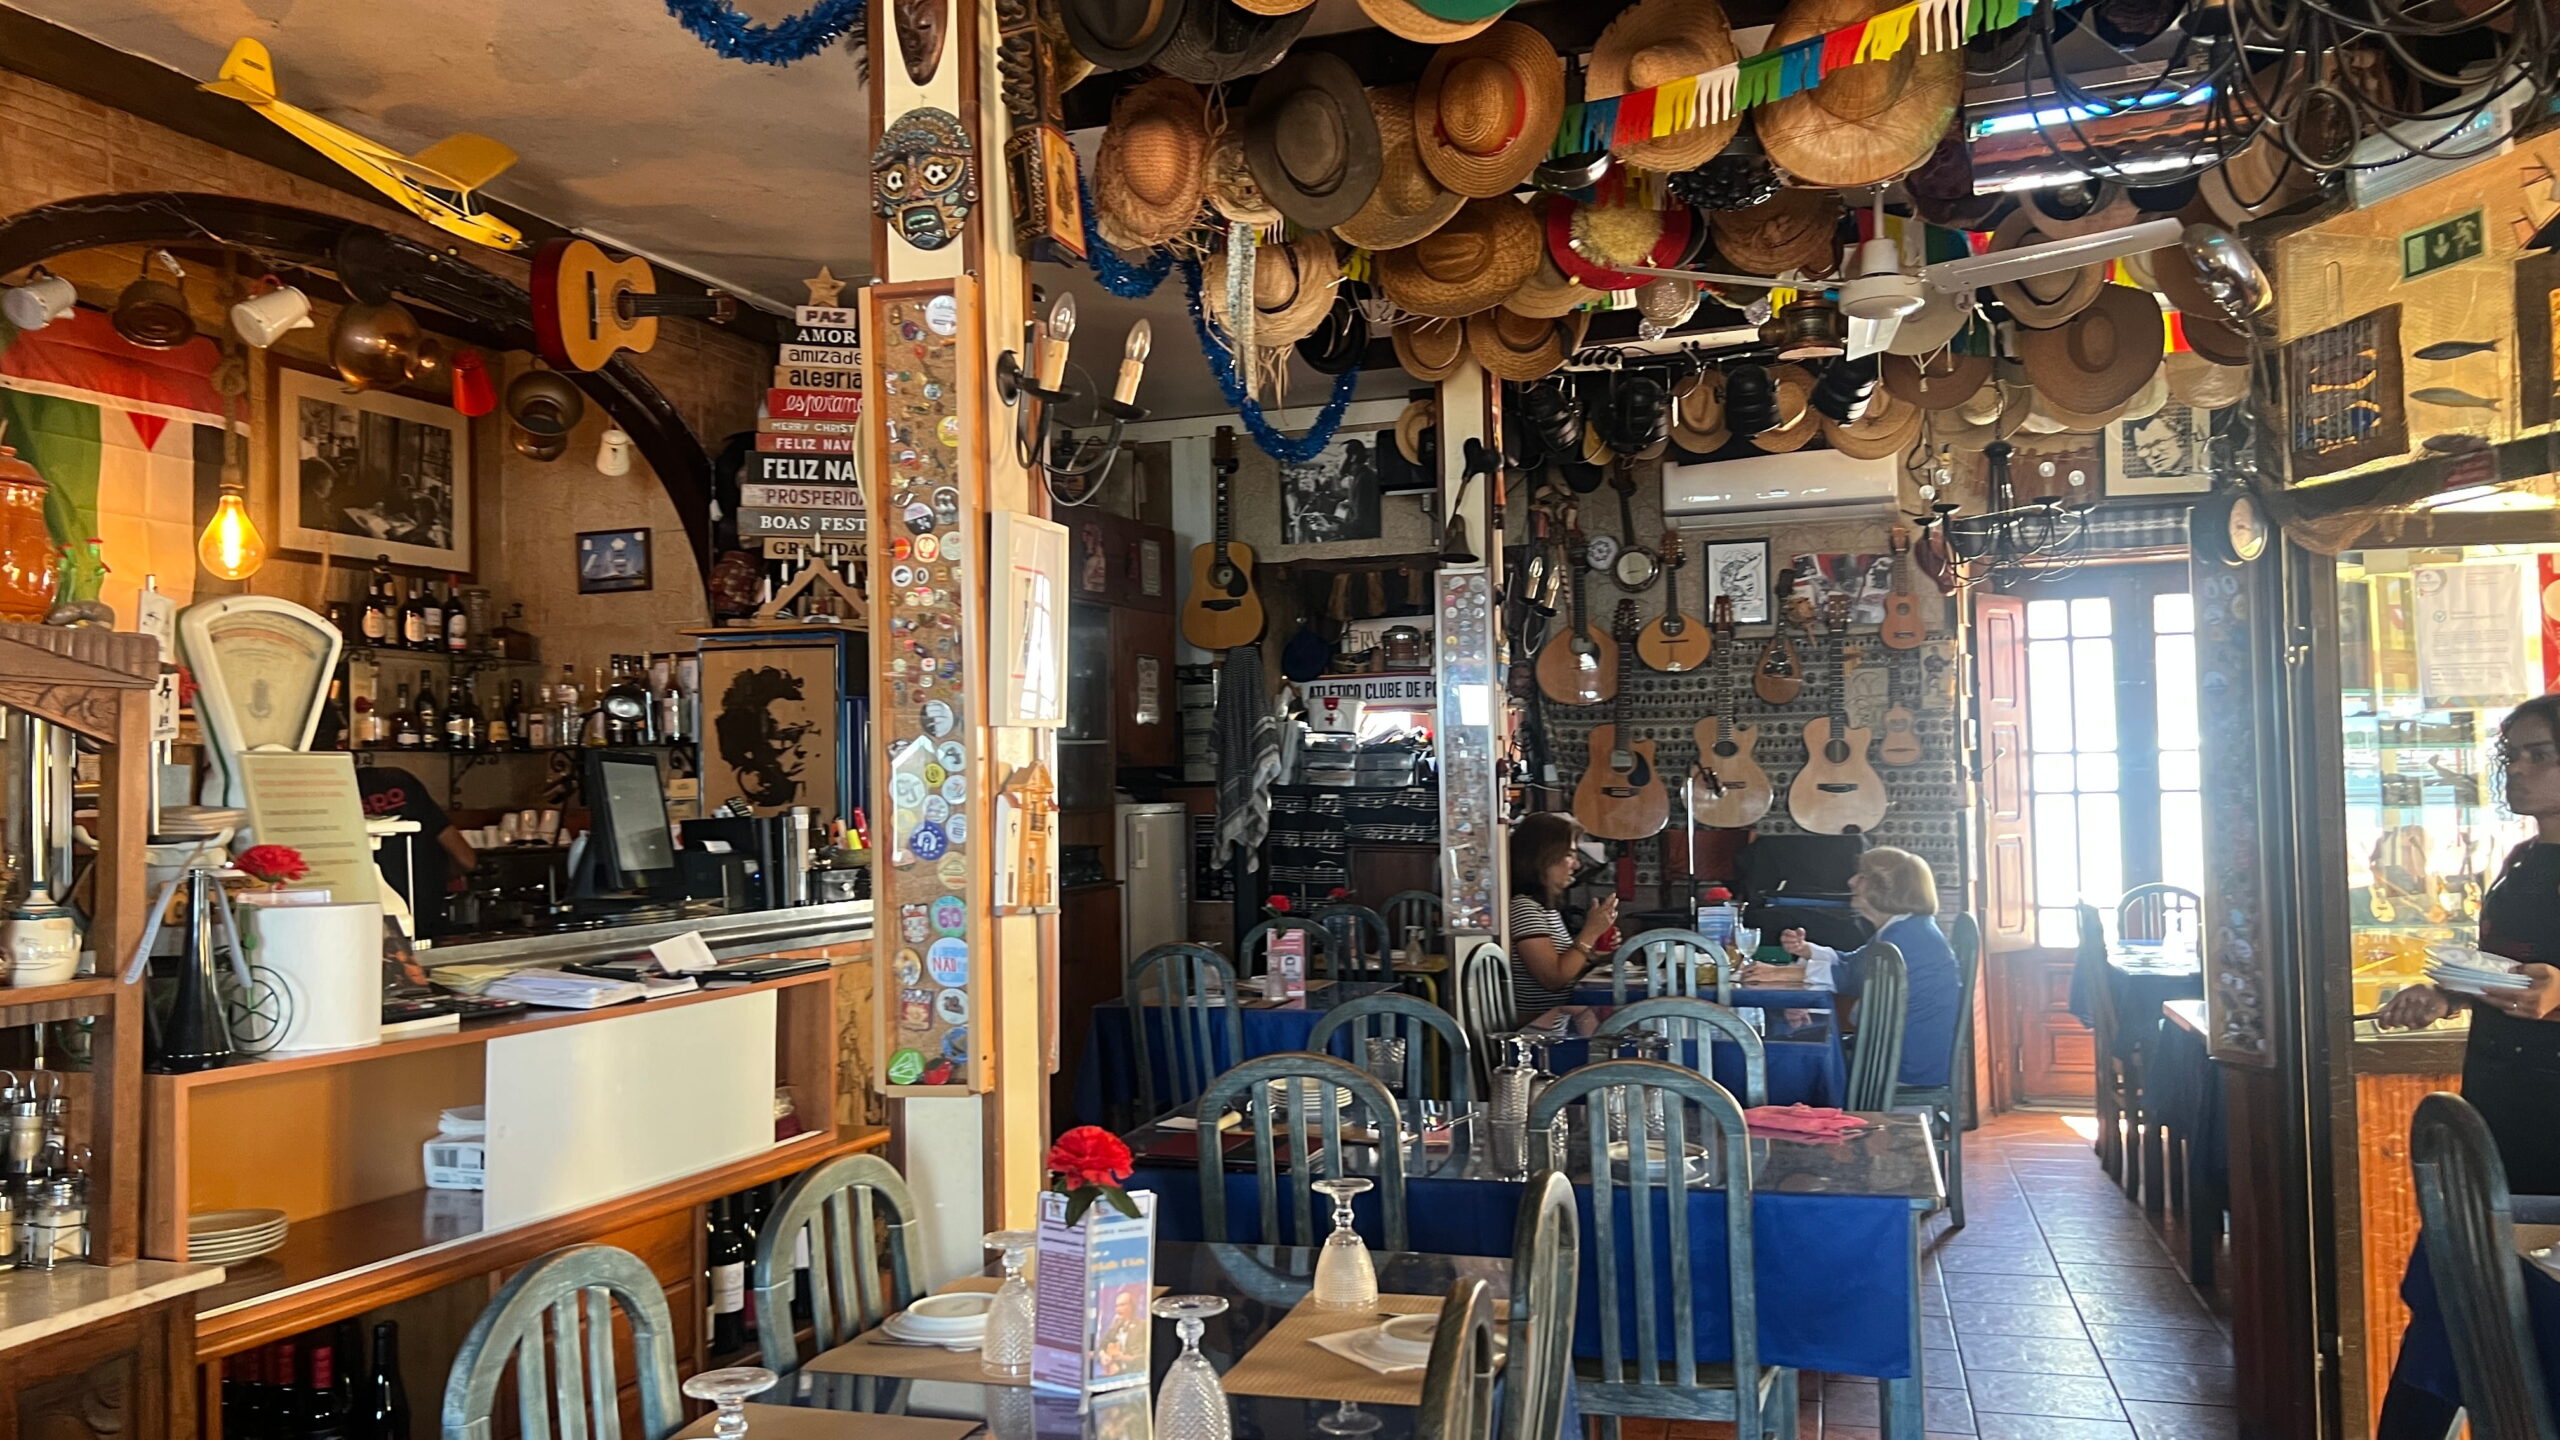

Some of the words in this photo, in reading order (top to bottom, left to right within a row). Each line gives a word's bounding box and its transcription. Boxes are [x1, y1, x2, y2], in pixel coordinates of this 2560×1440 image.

[805, 310, 847, 324] PAZ
[796, 328, 857, 344] AMOR
[789, 369, 863, 389] alegria
[771, 422, 810, 431] MERRY
[814, 423, 856, 433] CHRIST
[776, 437, 817, 450] FELIZ
[823, 439, 854, 451] NAV
[763, 458, 819, 480] FELIZ
[825, 460, 856, 481] NA
[760, 516, 811, 530] BOAS
[820, 517, 867, 531] FEST
[1365, 682, 1402, 700] CLUBE
[1406, 681, 1421, 698] DE
